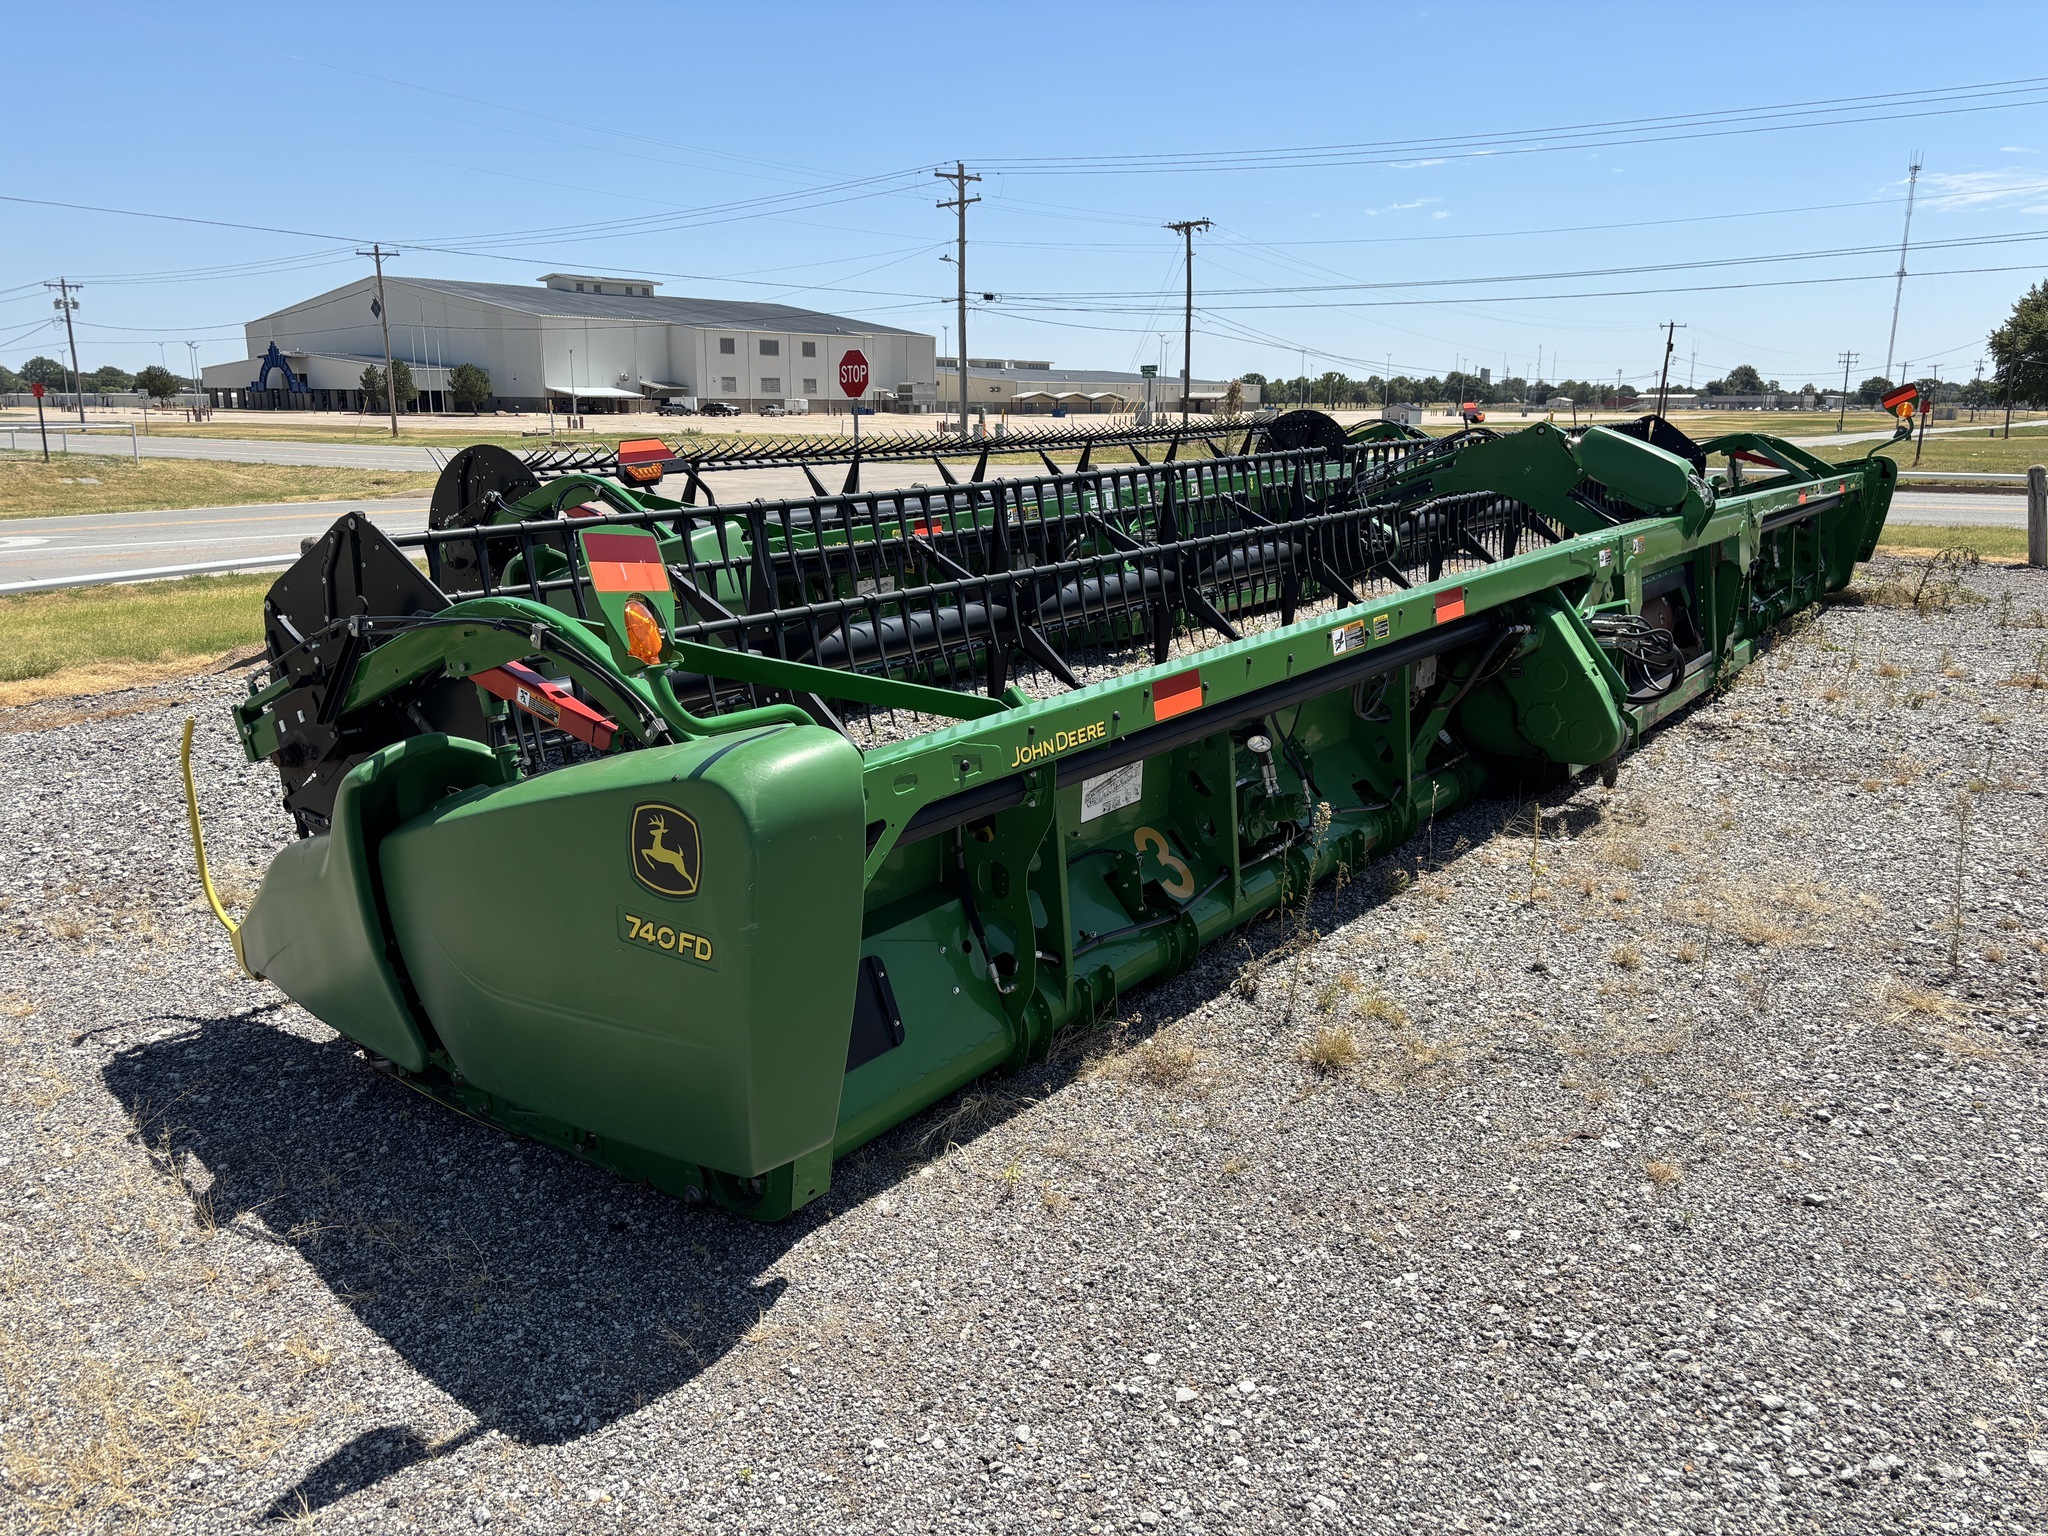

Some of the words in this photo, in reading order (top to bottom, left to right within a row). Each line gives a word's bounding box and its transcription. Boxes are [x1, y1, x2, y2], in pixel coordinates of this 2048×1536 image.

[841, 365, 866, 383] STOP
[1011, 738, 1055, 768] JOHN
[1055, 721, 1107, 752] DEERE
[1133, 826, 1195, 899] 3
[624, 912, 713, 962] 740FD
